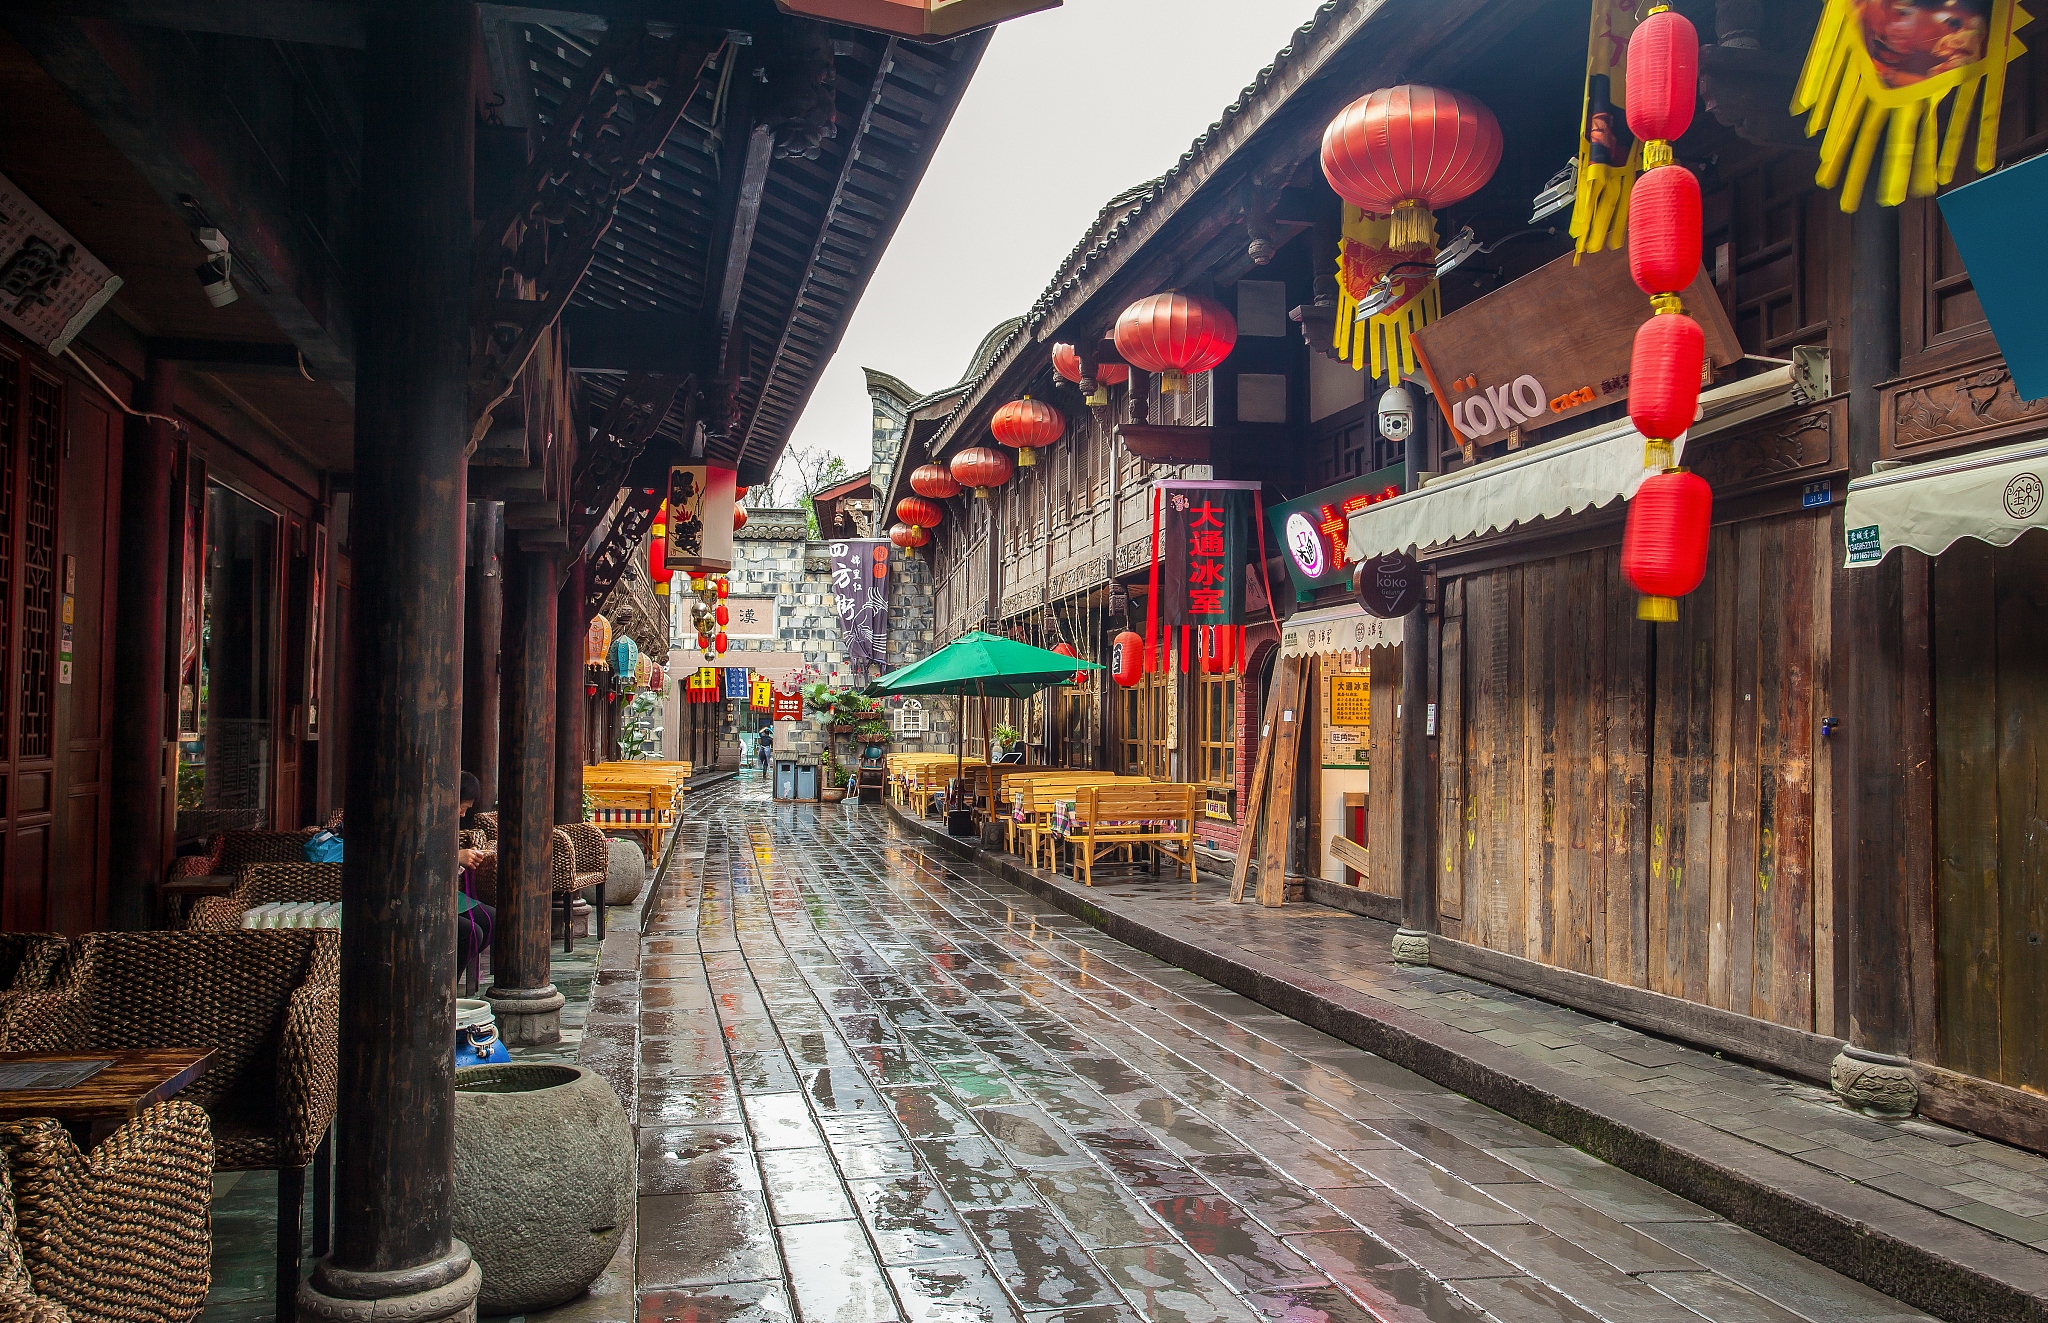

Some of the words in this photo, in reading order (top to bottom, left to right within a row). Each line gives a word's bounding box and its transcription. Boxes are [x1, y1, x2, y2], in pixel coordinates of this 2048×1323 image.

[1550, 385, 1597, 414] casa
[829, 543, 856, 622] 四方街
[1189, 500, 1226, 614] 大通冰室
[739, 608, 759, 624] 漢
